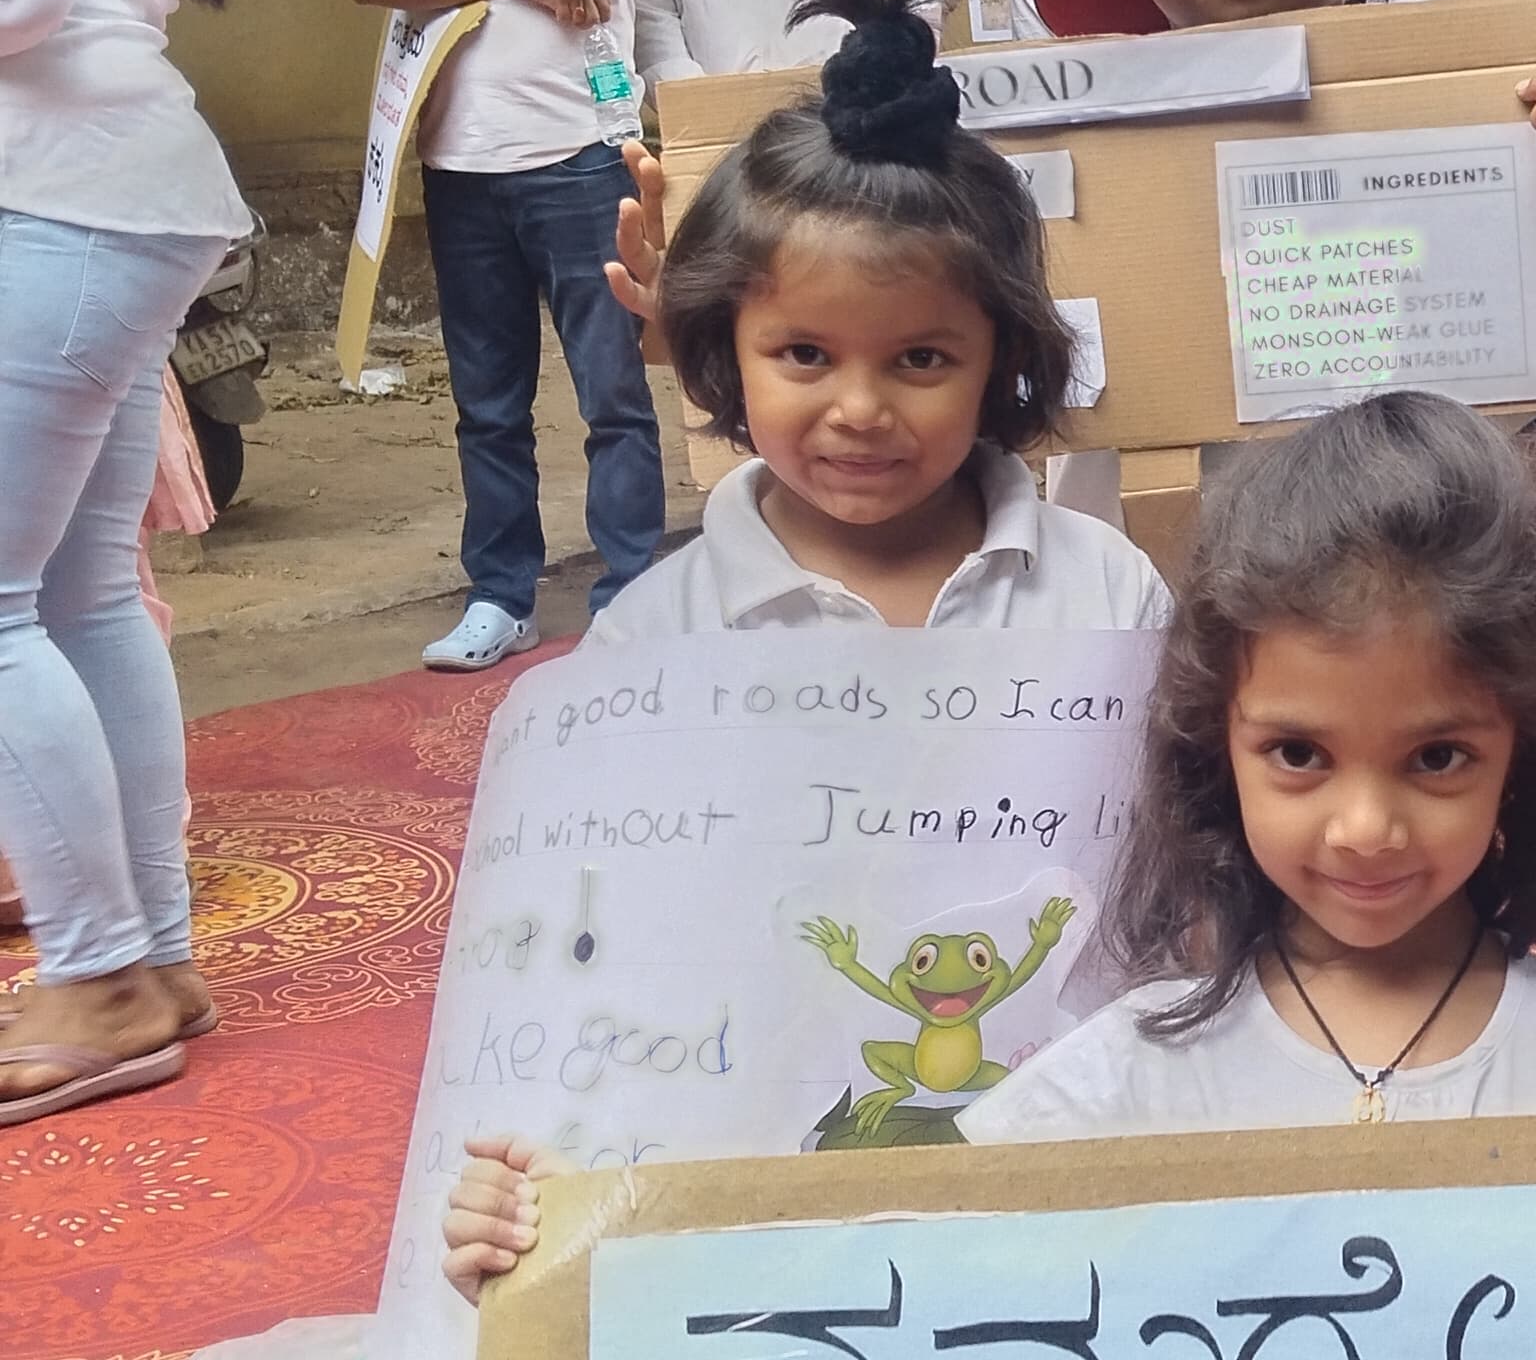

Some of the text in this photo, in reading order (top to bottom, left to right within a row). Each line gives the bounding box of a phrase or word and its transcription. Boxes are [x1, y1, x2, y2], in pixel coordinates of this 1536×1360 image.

[1363, 166, 1504, 192] INGREDIENTS
[1241, 217, 1295, 239] DUST
[1246, 238, 1415, 267] QUICK PATCHES
[1248, 265, 1425, 296] CHEAP MATERIAL
[1250, 291, 1488, 323] NO DRAINAGE SYSTEM
[1252, 318, 1496, 353] MONSOON-WEAK GLUE
[1254, 346, 1497, 381] ZERO ACCOUNTABILITY
[556, 667, 664, 747] good
[712, 674, 888, 719] roads
[545, 801, 736, 848] without
[802, 784, 1067, 848] Jumping
[560, 1003, 734, 1093] good
